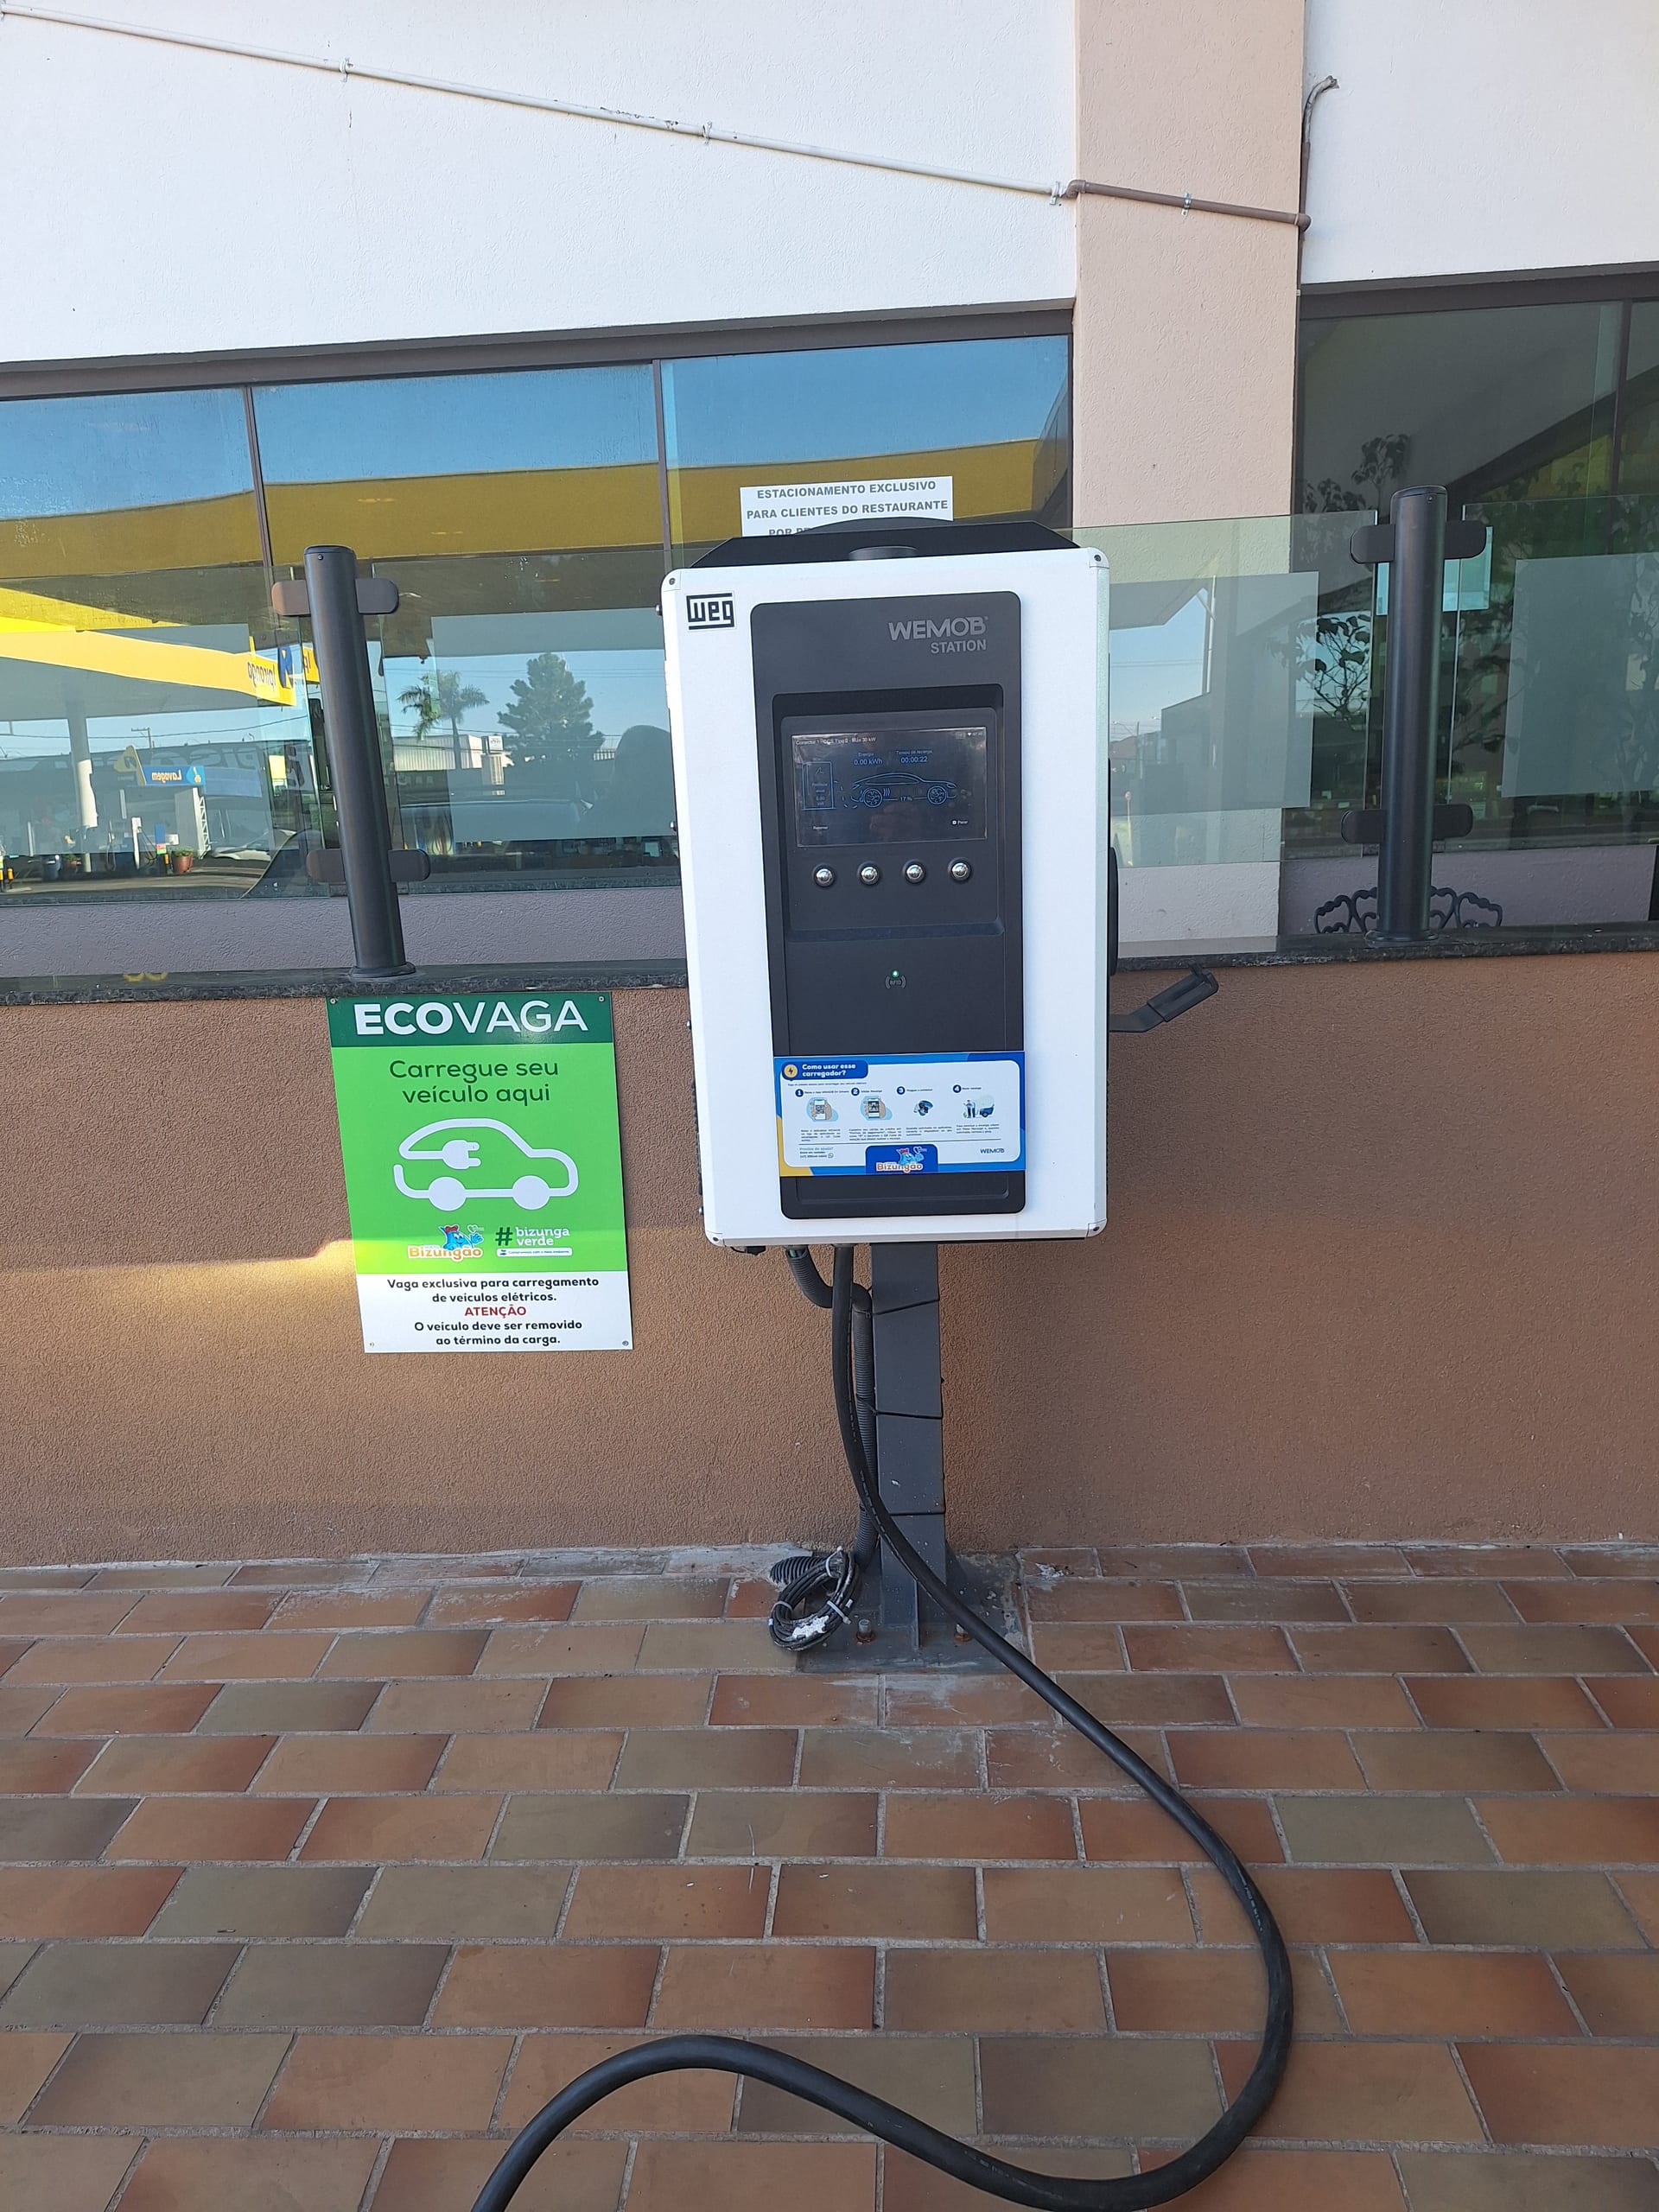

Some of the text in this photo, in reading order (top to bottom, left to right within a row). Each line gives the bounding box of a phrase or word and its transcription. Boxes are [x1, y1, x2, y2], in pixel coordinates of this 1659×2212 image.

[757, 480, 937, 499] ESTACIONAMENTO EXCLUSIVO
[747, 500, 949, 519] PARA CLIENTES DO RESTAURANTE
[769, 528, 792, 537] POR
[888, 615, 987, 641] WEMOB
[931, 639, 987, 655] STATION
[353, 1000, 588, 1036] ECOVAGA
[389, 1060, 559, 1084] Carregue seu
[402, 1084, 550, 1107] veículo aqui
[516, 1227, 570, 1238] bizunga
[517, 1236, 554, 1246] verde
[409, 1246, 482, 1261] Bizungão
[387, 1277, 599, 1292] Vaga exclusiva para carregamento
[432, 1291, 557, 1303] de veículos elétricos.
[464, 1305, 526, 1319] ATENÇÃO
[414, 1322, 423, 1332] O
[427, 1321, 468, 1332] veículo
[472, 1320, 501, 1331] deve
[525, 1319, 582, 1330] removido
[435, 1334, 561, 1347] ao término da carga.
